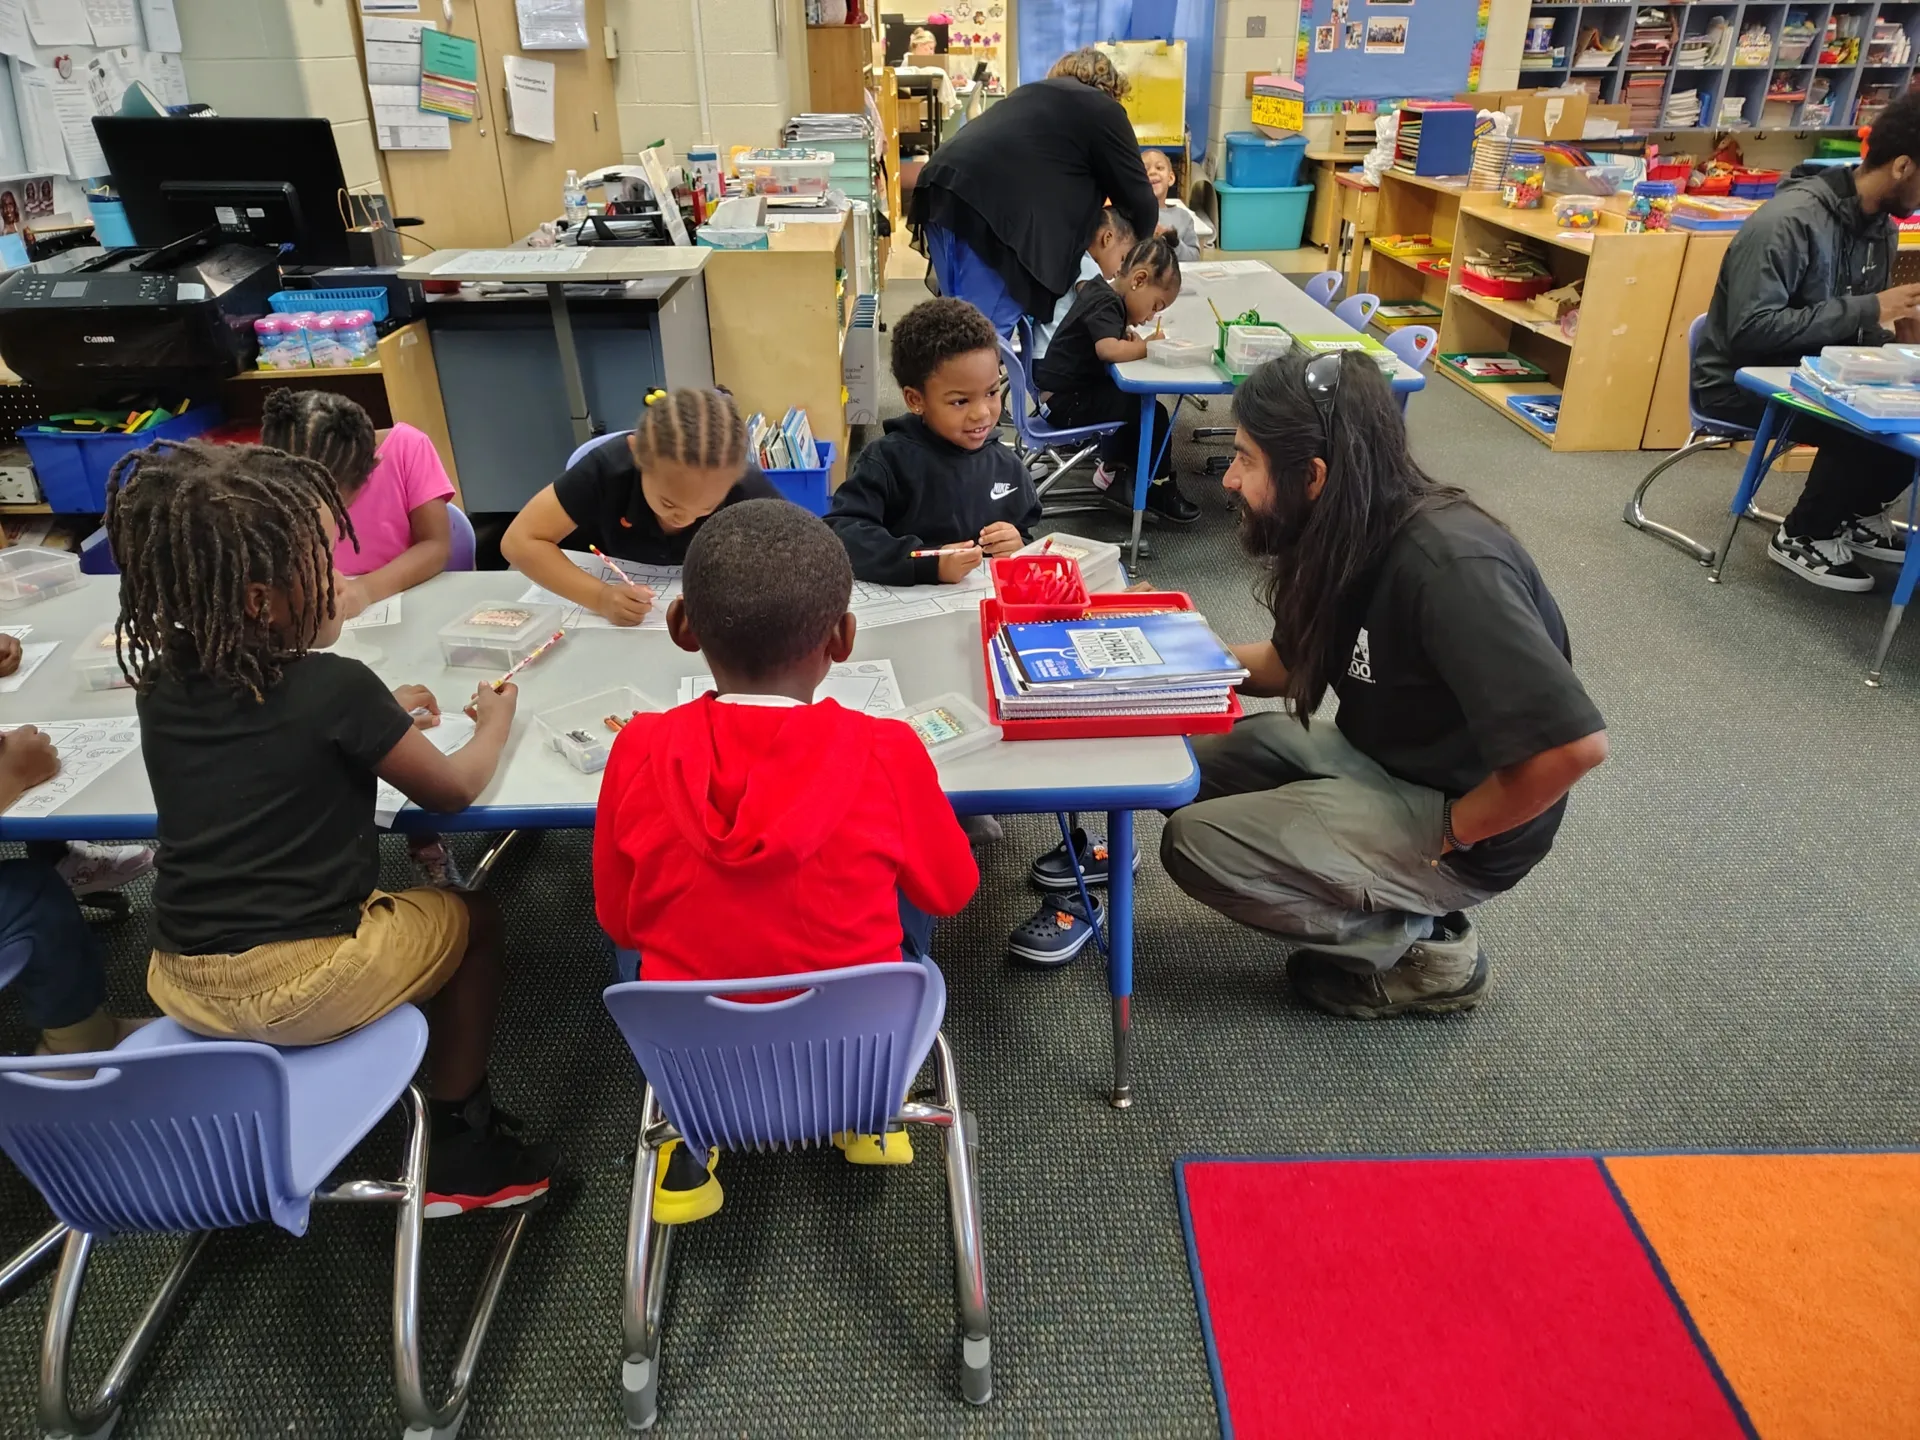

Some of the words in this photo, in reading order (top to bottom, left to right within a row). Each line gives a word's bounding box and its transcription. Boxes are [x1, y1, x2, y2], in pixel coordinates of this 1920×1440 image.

[83, 335, 116, 343] Canon
[993, 482, 1011, 494] NIKE
[1074, 631, 1115, 666] NOTEBOOK
[1097, 630, 1137, 664] ALPHABET
